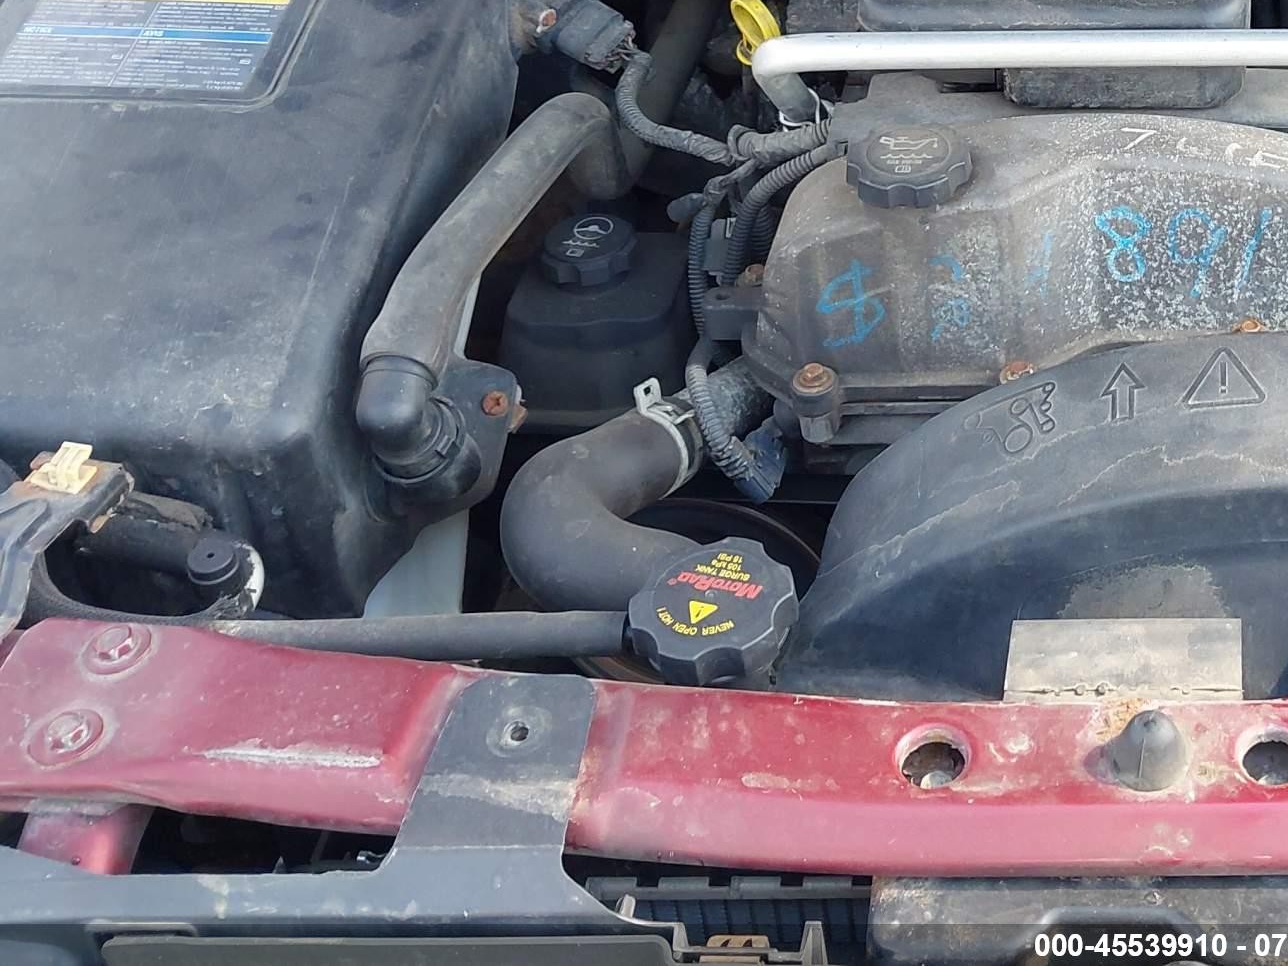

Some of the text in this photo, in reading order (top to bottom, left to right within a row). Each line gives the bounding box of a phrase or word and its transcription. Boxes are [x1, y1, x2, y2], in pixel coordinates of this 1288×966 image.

[695, 563, 750, 581] SURGE TANK
[672, 623, 698, 636] OPEN
[701, 619, 735, 636] NEVER
